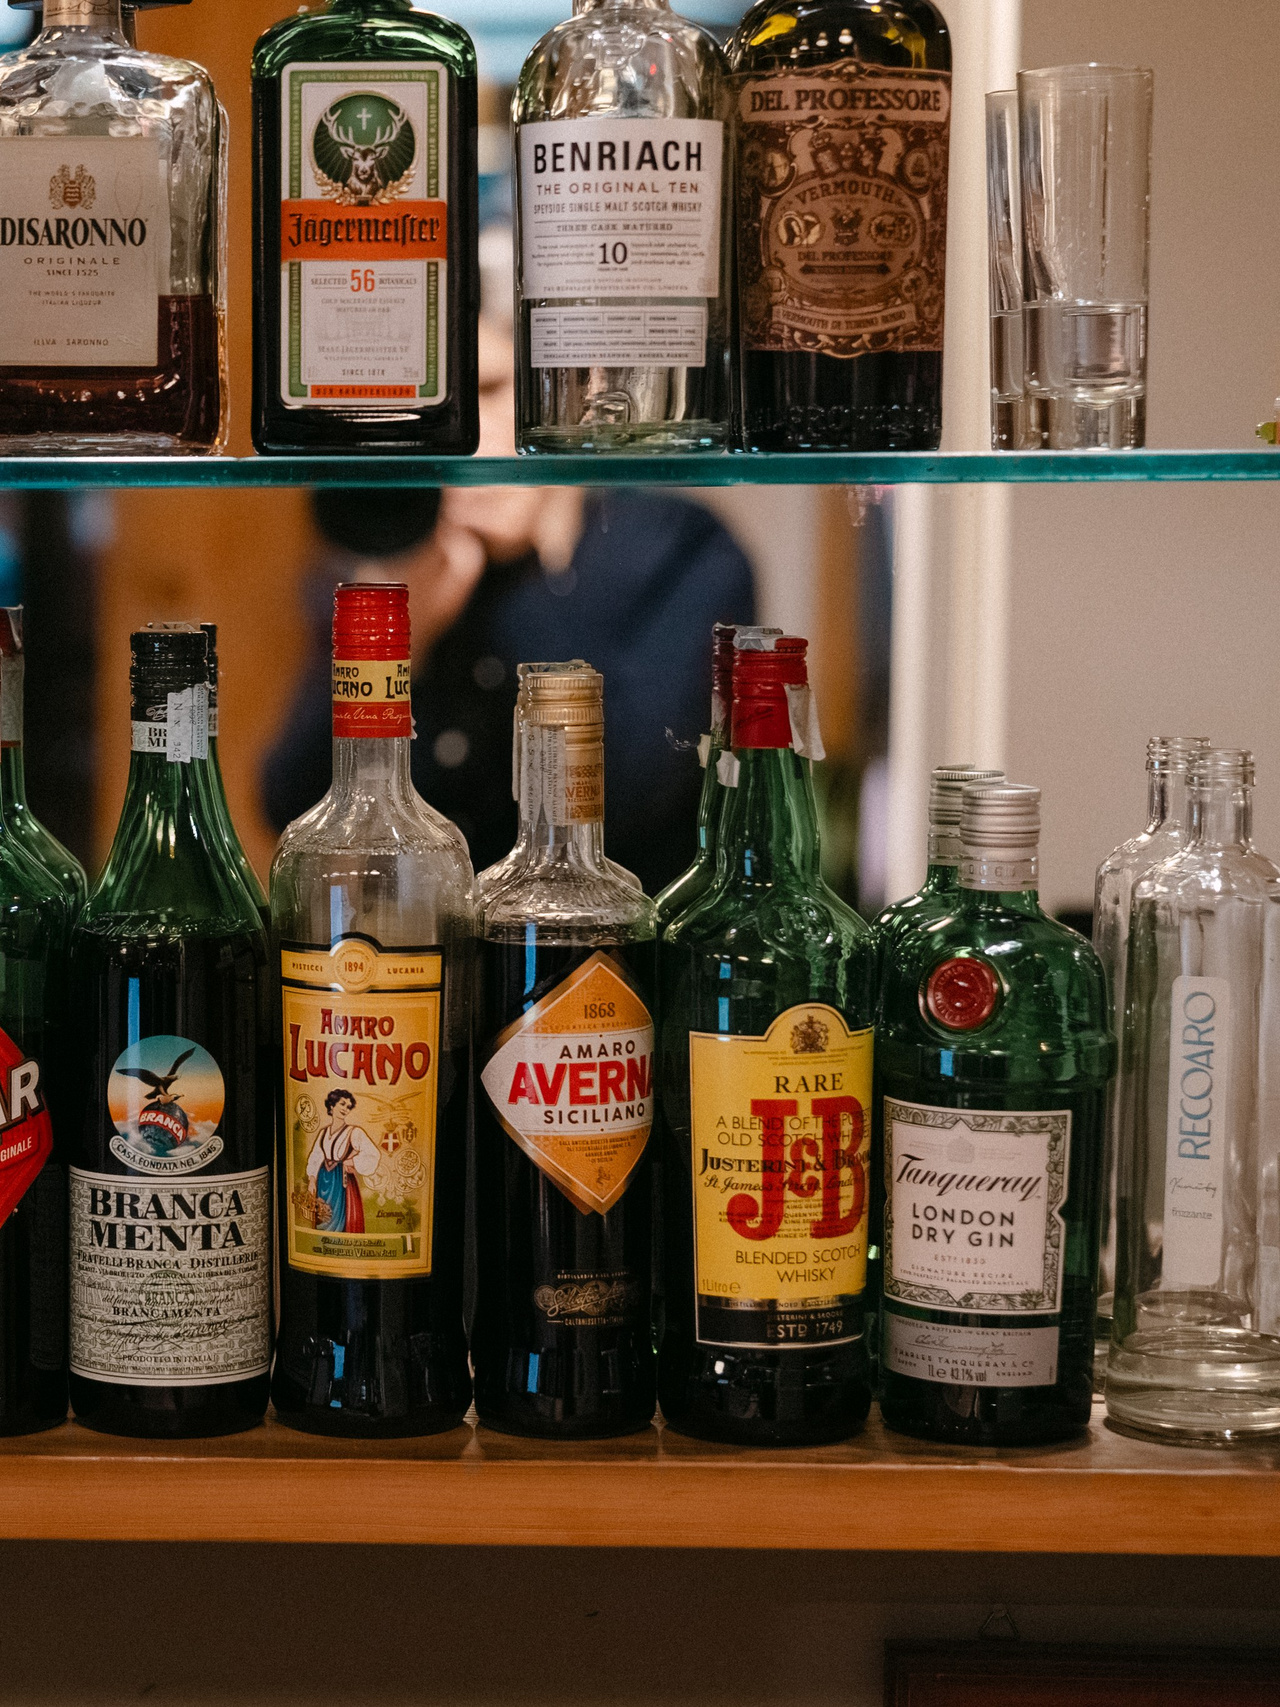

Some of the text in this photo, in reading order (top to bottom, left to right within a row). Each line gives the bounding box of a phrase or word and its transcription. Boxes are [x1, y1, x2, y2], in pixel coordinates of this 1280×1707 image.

[750, 88, 941, 113] DEL PROFESSORE
[533, 140, 703, 174] BENRIACH
[536, 181, 700, 196] THE ORIGINAL TEN
[795, 180, 899, 203] VERMOUTH
[533, 201, 703, 214] SPEYSIDE SINGLE MALT SCOTCH WHISKY
[0, 217, 147, 249] DISARONNO
[23, 257, 121, 265] ORIGINALE
[598, 241, 628, 265] 10
[76, 268, 99, 276] 1525
[310, 268, 376, 293] SELECTED 56
[344, 961, 364, 973] 1894
[386, 966, 425, 975] LUCANIA
[583, 1002, 616, 1020] 1868
[320, 1007, 395, 1040] AMARO
[288, 1021, 432, 1086] LUCANO
[558, 1039, 637, 1060] AMARO
[773, 1071, 844, 1094] RARE
[1177, 990, 1217, 1161] RECOARO
[543, 1102, 646, 1125] SICILIANO
[715, 1115, 811, 1130] A BLEND OF
[139, 1111, 185, 1142] BRANCA
[717, 1131, 824, 1148] OLD SCOTCH
[116, 1143, 217, 1171] CASA FONDATA 1845
[699, 1147, 807, 1176] JUSTERINI
[726, 1095, 866, 1242] J&B
[895, 1153, 1042, 1202] Tanqueray
[88, 1187, 247, 1220] BRANCA
[912, 1202, 1015, 1227] LONDON
[88, 1219, 247, 1252] MENTA
[912, 1223, 1014, 1248] DRY GIN
[125, 1256, 181, 1269] BRANCA
[189, 1251, 260, 1269] DISTILLERIE
[735, 1243, 862, 1265] BLENDED SCOTCH
[776, 1266, 837, 1283] WHISKY
[112, 1306, 222, 1319] BRANCAMENTA
[815, 1320, 844, 1336] 1749
[121, 1354, 171, 1363] PRODOTTO
[183, 1353, 214, 1363] ITALIA
[937, 1355, 1007, 1369] TANQUERAY
